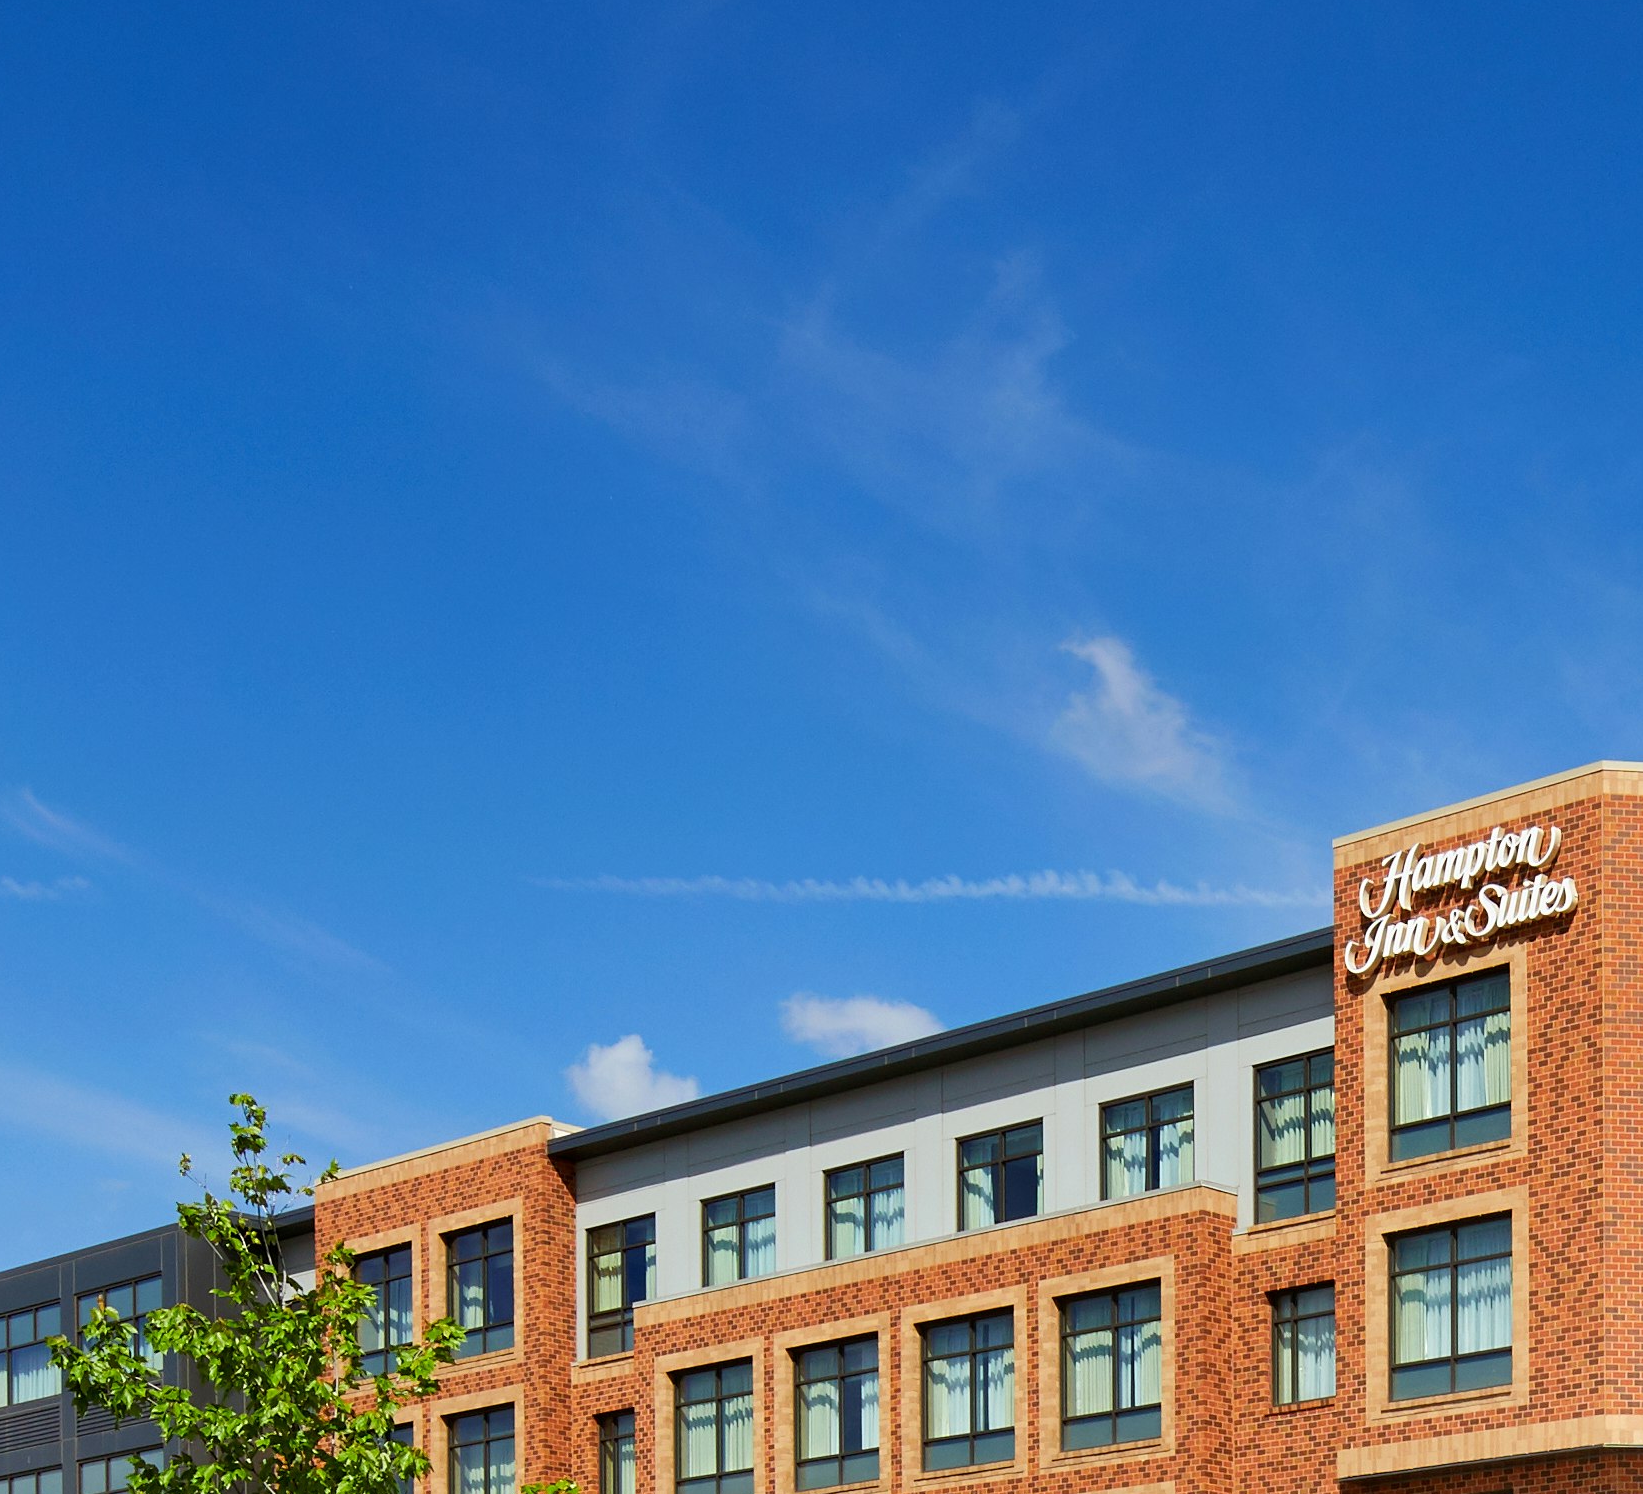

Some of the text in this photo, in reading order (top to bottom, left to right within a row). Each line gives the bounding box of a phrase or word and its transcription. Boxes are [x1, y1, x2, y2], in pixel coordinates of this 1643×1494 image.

[1359, 825, 1562, 918] Hampton
[1344, 873, 1579, 975] Inn & Suites
